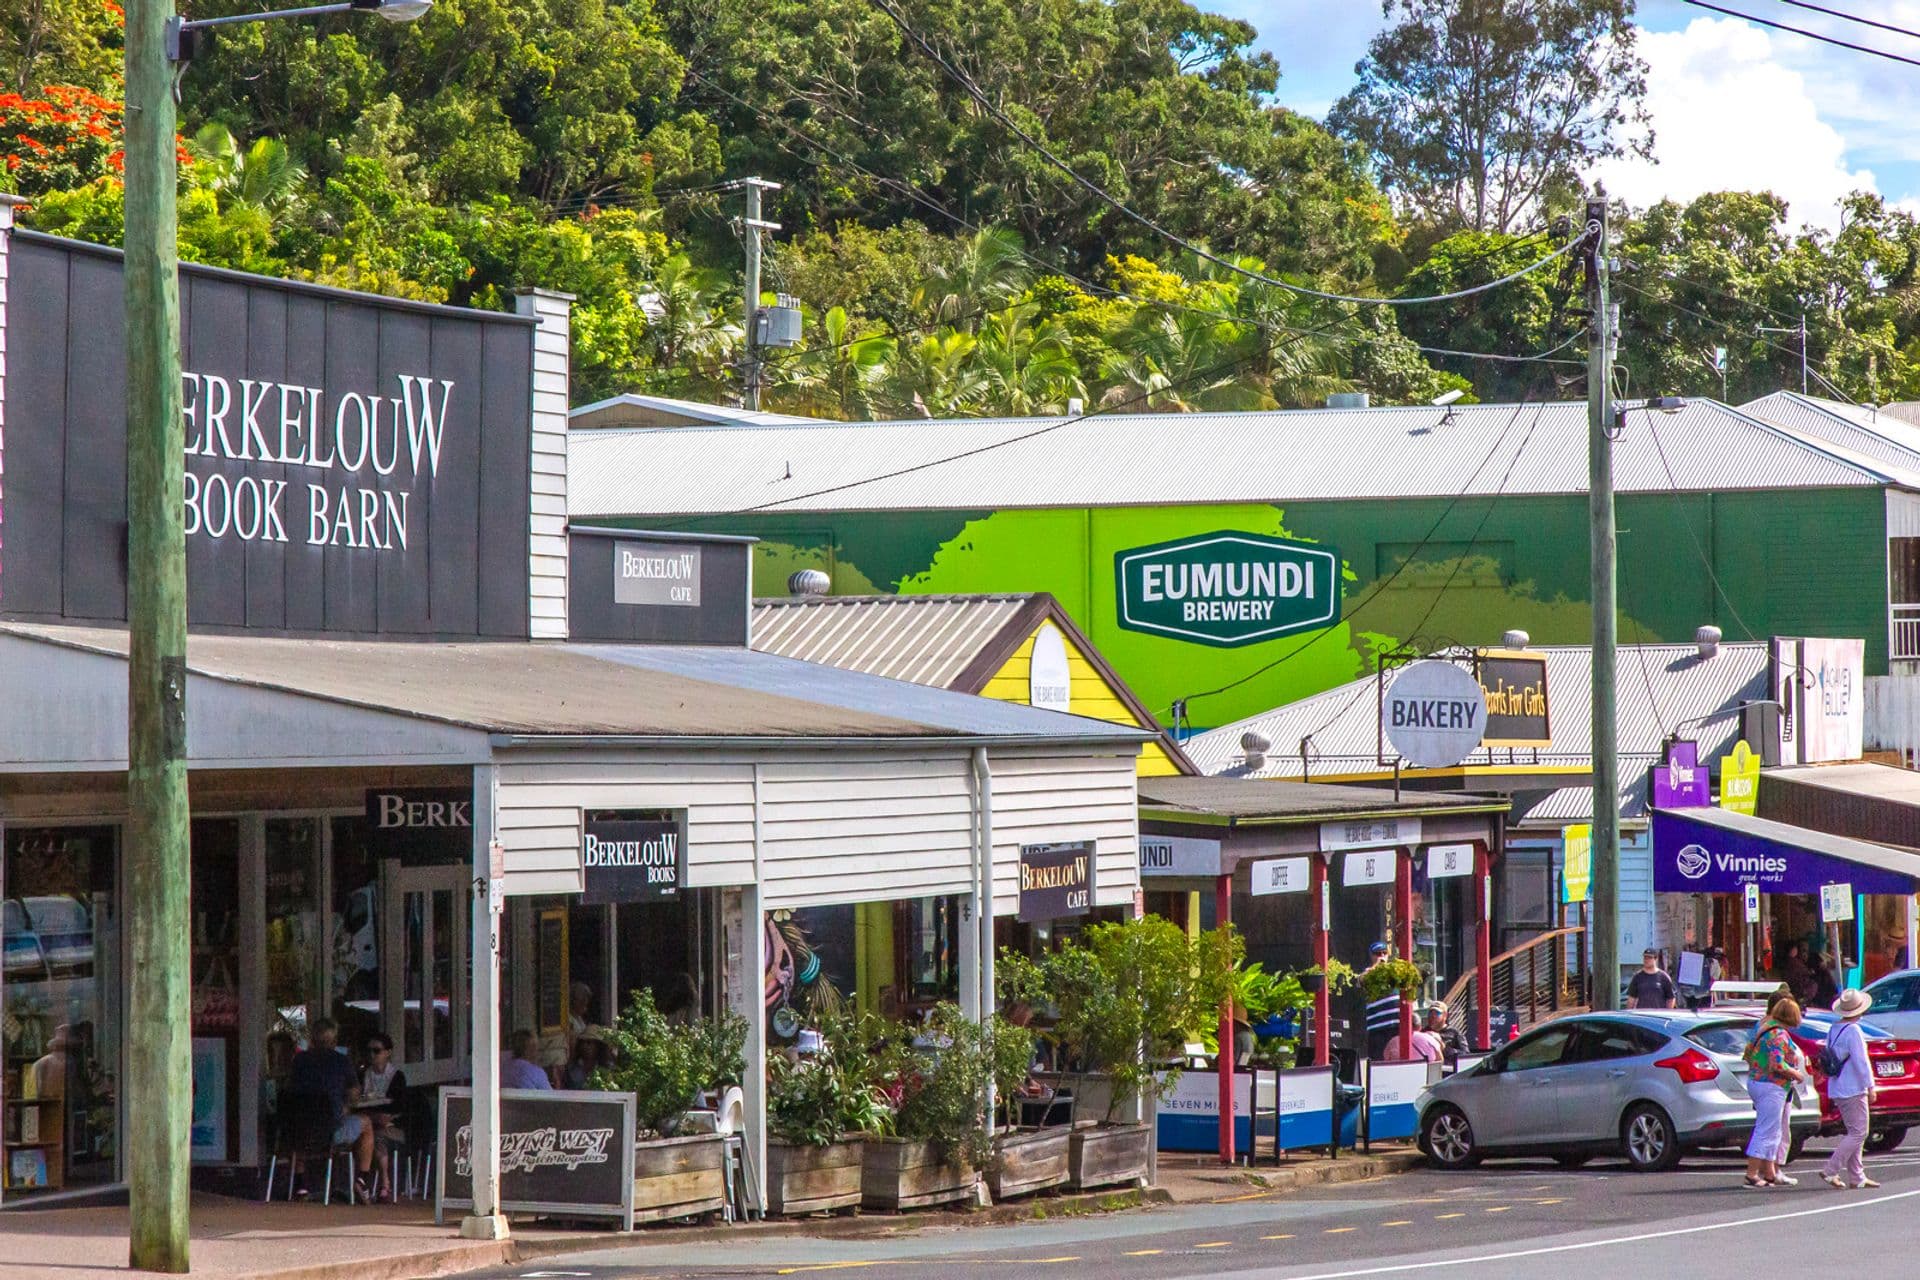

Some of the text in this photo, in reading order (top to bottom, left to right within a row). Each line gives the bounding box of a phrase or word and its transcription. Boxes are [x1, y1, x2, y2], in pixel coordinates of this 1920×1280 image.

[184, 472, 409, 550] BOOK BARN
[622, 551, 694, 580] BERKELOUW
[670, 586, 692, 601] CAFE
[1142, 561, 1315, 602] EUMUNDI
[1183, 601, 1275, 622] BREWERY
[1391, 700, 1478, 728] BAKERY
[377, 795, 472, 828] BERK
[585, 833, 677, 867] BERKELOUW
[1715, 853, 1787, 872] Vinnies
[648, 867, 676, 884] BOOKS
[1022, 856, 1087, 891] BERKELOUW
[1066, 890, 1088, 909] CAFE
[1165, 1100, 1239, 1110] SEVEN MIS
[560, 1128, 614, 1152] WEST
